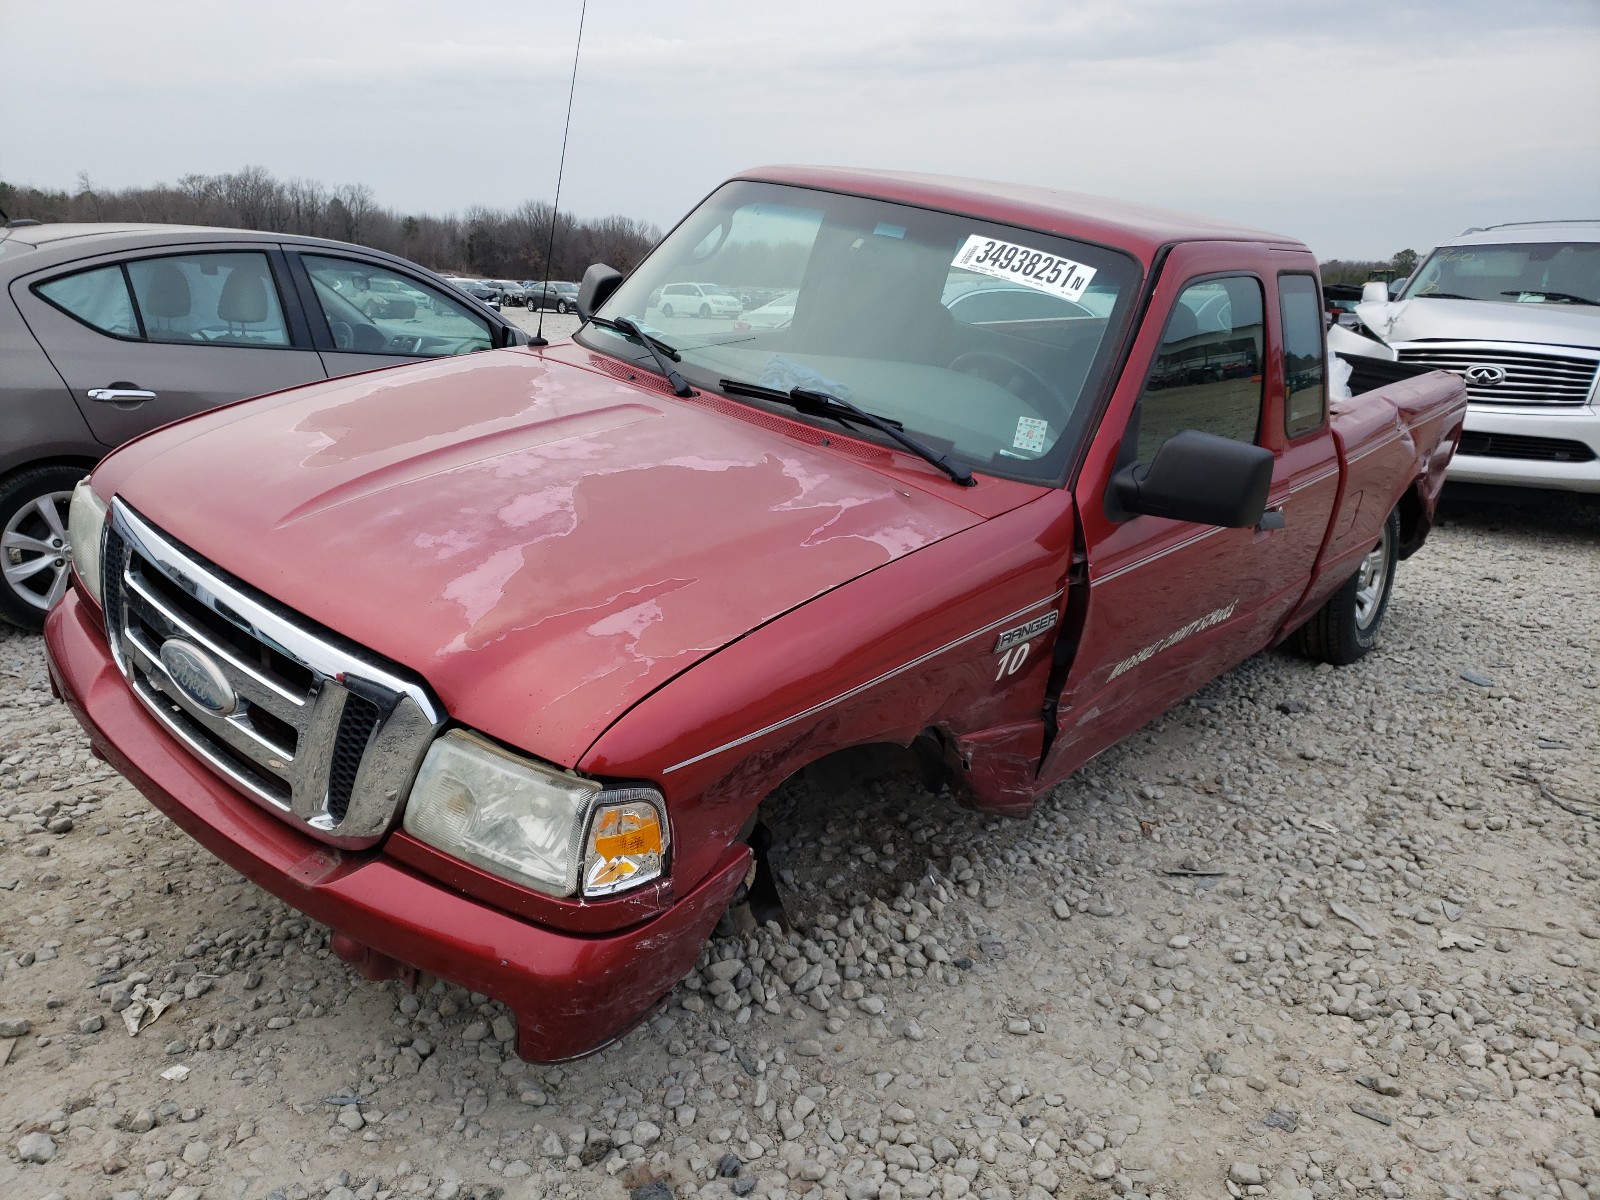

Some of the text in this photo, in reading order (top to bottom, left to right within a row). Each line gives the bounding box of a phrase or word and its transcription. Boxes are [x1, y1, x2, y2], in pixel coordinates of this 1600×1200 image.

[975, 241, 1077, 288] 34938251
[1071, 276, 1085, 290] N
[1000, 612, 1057, 646] RANGER
[995, 643, 1030, 681] 10
